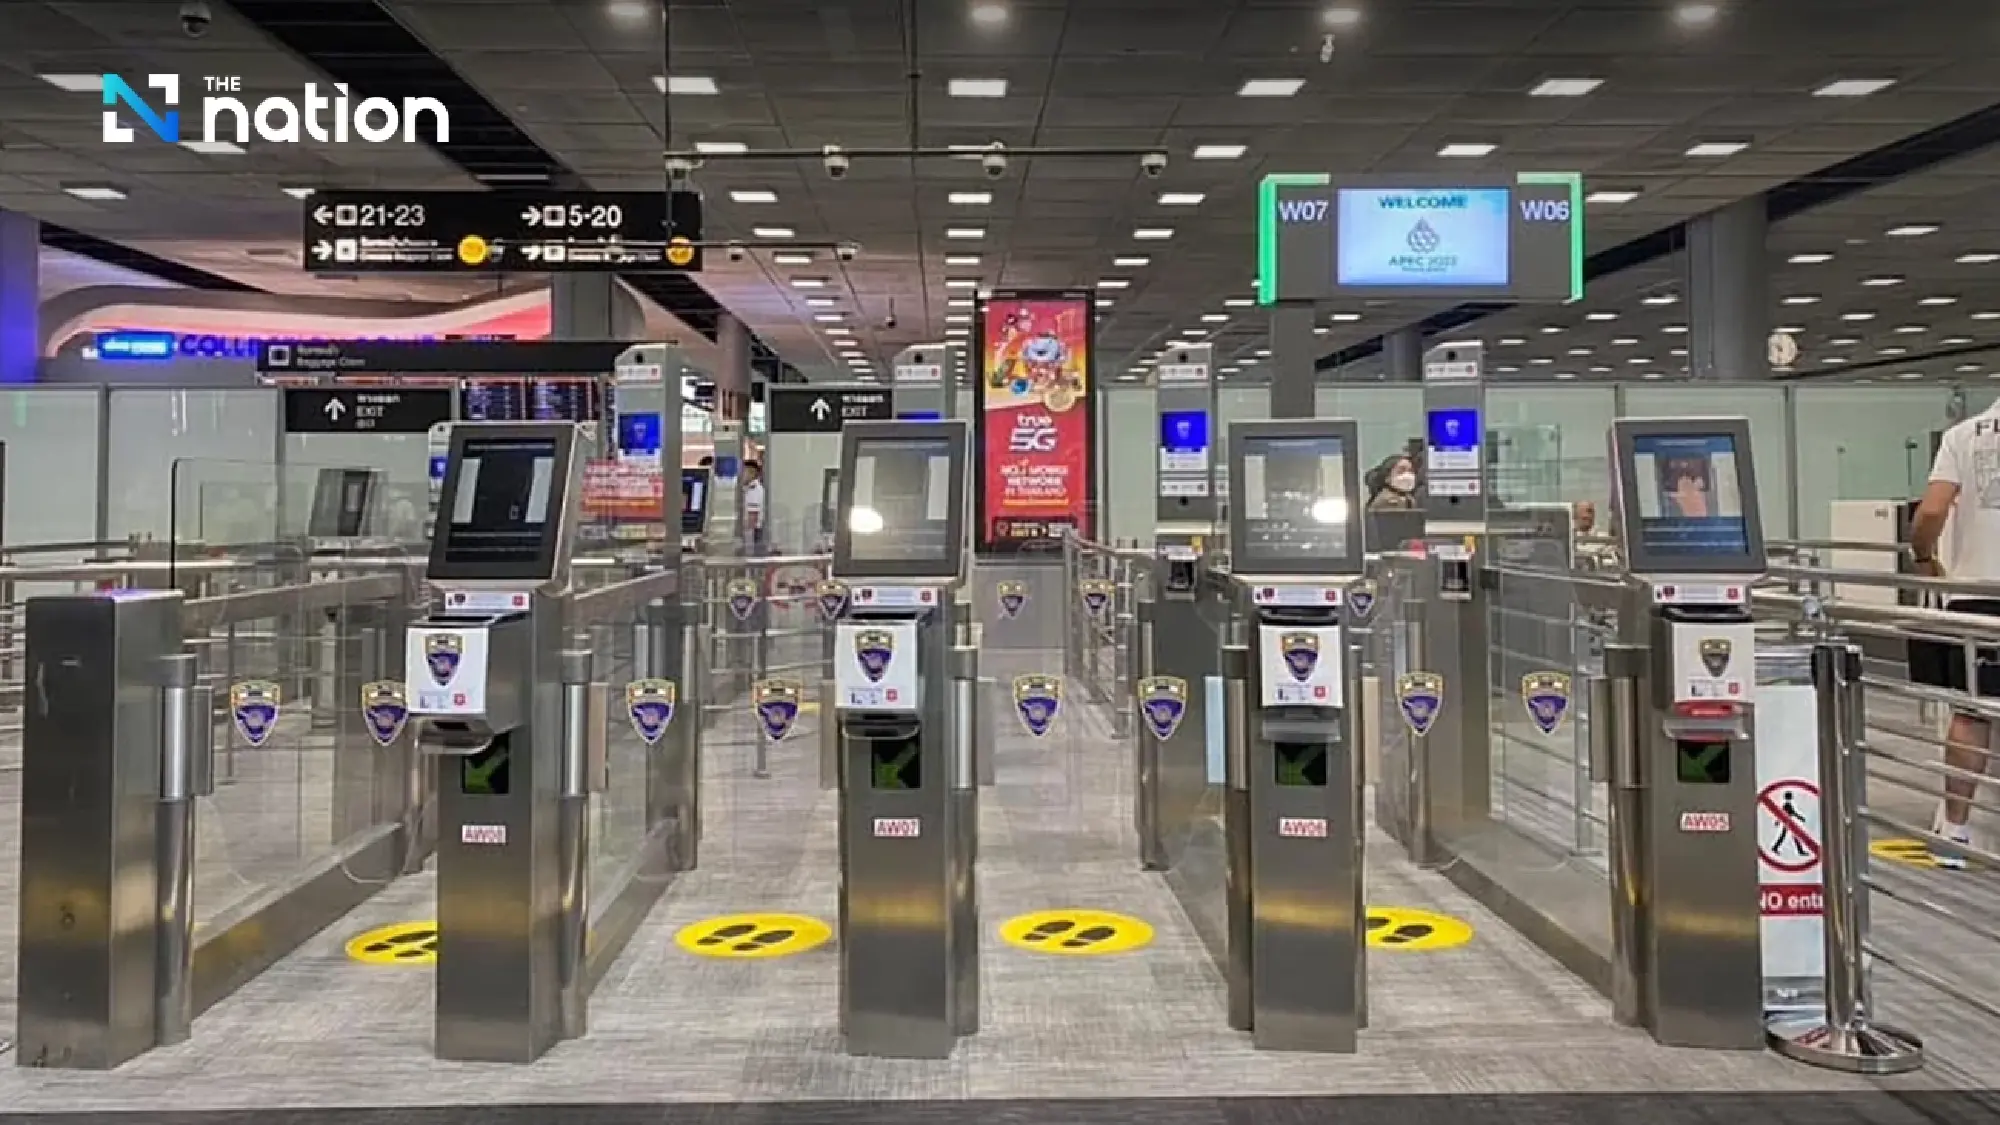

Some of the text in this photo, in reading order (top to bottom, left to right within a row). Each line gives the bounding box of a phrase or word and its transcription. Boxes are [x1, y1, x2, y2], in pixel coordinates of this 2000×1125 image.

[1378, 194, 1468, 208] WELCOME
[360, 204, 426, 226] 21-23
[568, 205, 623, 227] 5-20
[1278, 200, 1329, 221] W07
[1519, 200, 1570, 221] W06
[356, 406, 384, 417] EXIT
[841, 406, 868, 417] EXIT
[1017, 413, 1052, 427] true
[1009, 428, 1058, 451] 5G
[877, 821, 916, 834] AW07
[1685, 815, 1727, 829] AW05
